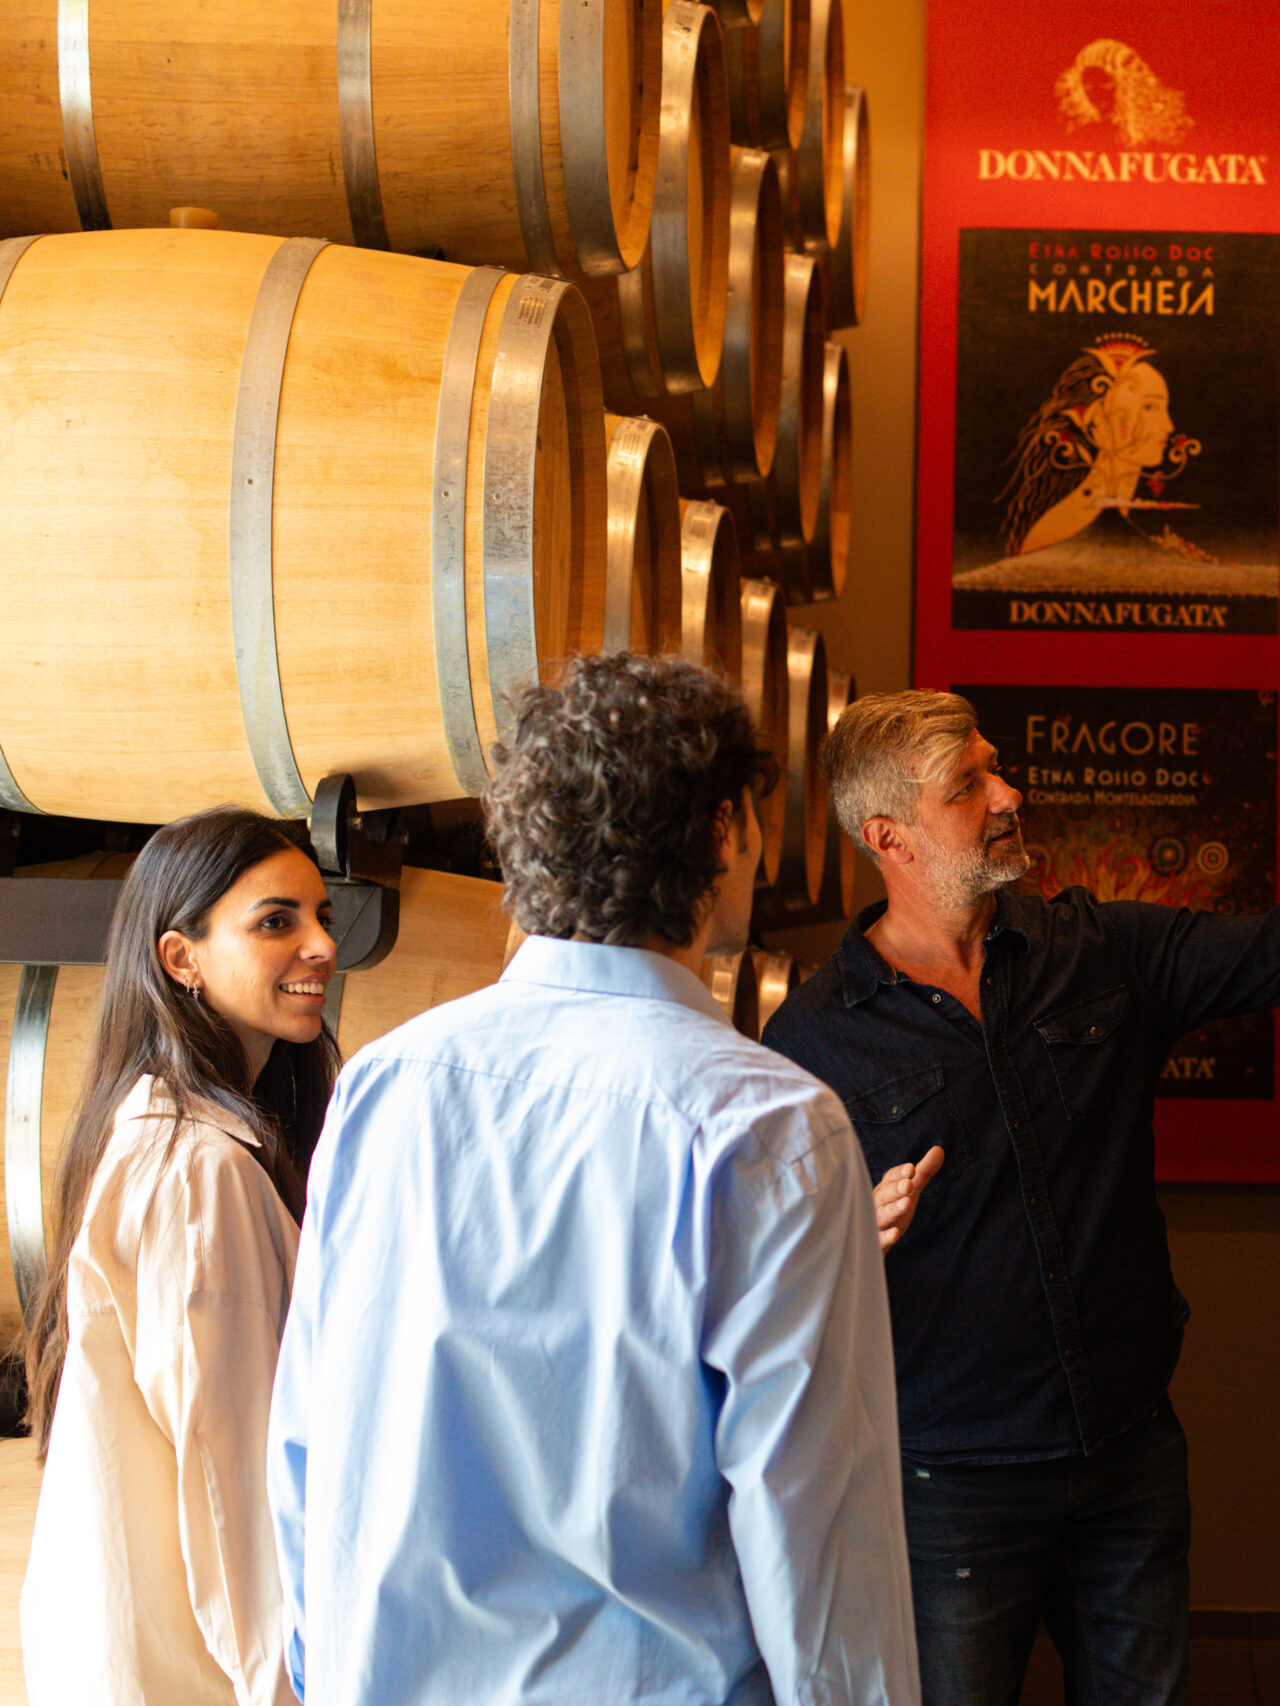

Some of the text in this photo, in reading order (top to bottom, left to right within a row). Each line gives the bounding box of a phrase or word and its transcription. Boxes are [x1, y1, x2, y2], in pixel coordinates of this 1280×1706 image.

[1090, 243, 1158, 260] ROSSO
[1169, 244, 1214, 261] DOC
[1028, 278, 1214, 315] MARCHESA
[1026, 714, 1198, 755] FRAGORE
[1084, 767, 1146, 787] ROSSO
[1156, 768, 1198, 788] DOC
